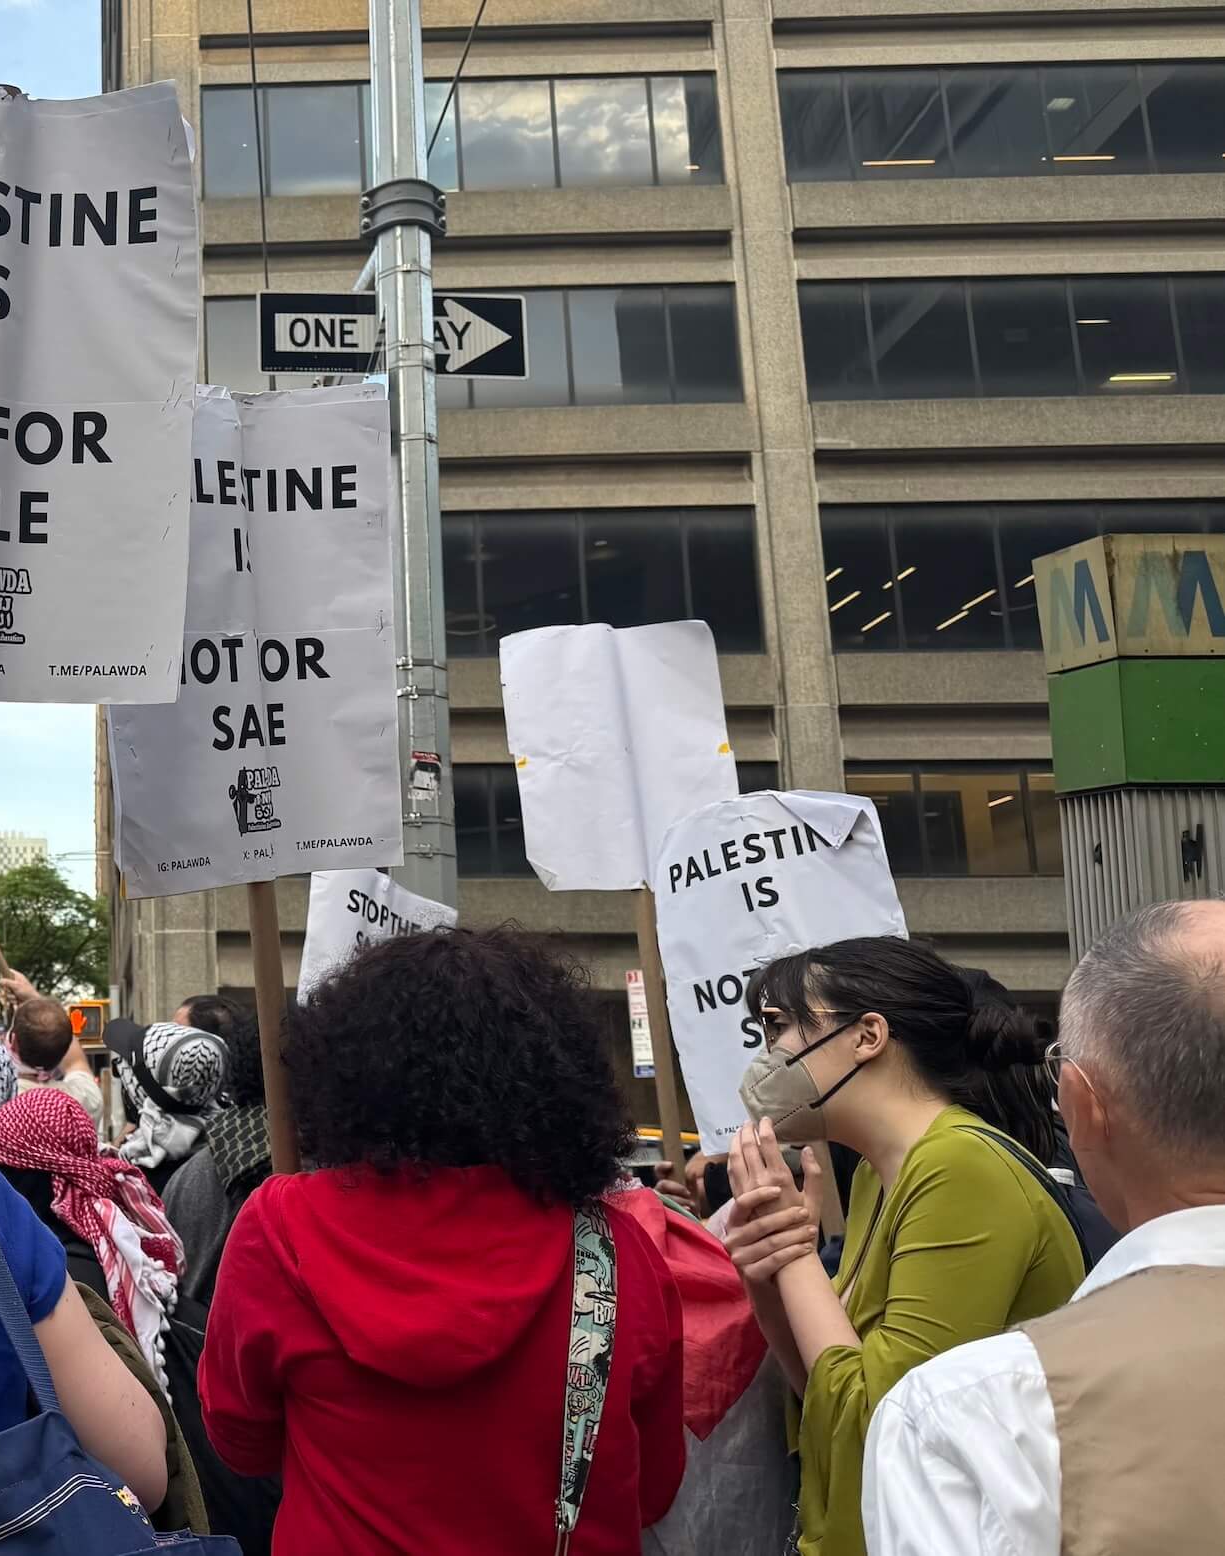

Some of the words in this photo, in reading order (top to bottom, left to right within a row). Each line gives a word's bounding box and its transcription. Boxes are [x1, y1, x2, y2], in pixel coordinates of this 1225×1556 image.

[289, 318, 358, 348] ONE
[434, 321, 471, 350] AY
[190, 458, 357, 512] LETINE
[48, 664, 147, 677] T.ME/PALAWDA
[157, 861, 170, 872] IG:
[171, 856, 211, 870] PALAWDA
[296, 836, 373, 850] T.ME/PALAWDA
[669, 822, 841, 893] PALESTIN
[347, 889, 389, 927] STOP
[741, 876, 780, 912] IS
[693, 967, 763, 1014] NO
